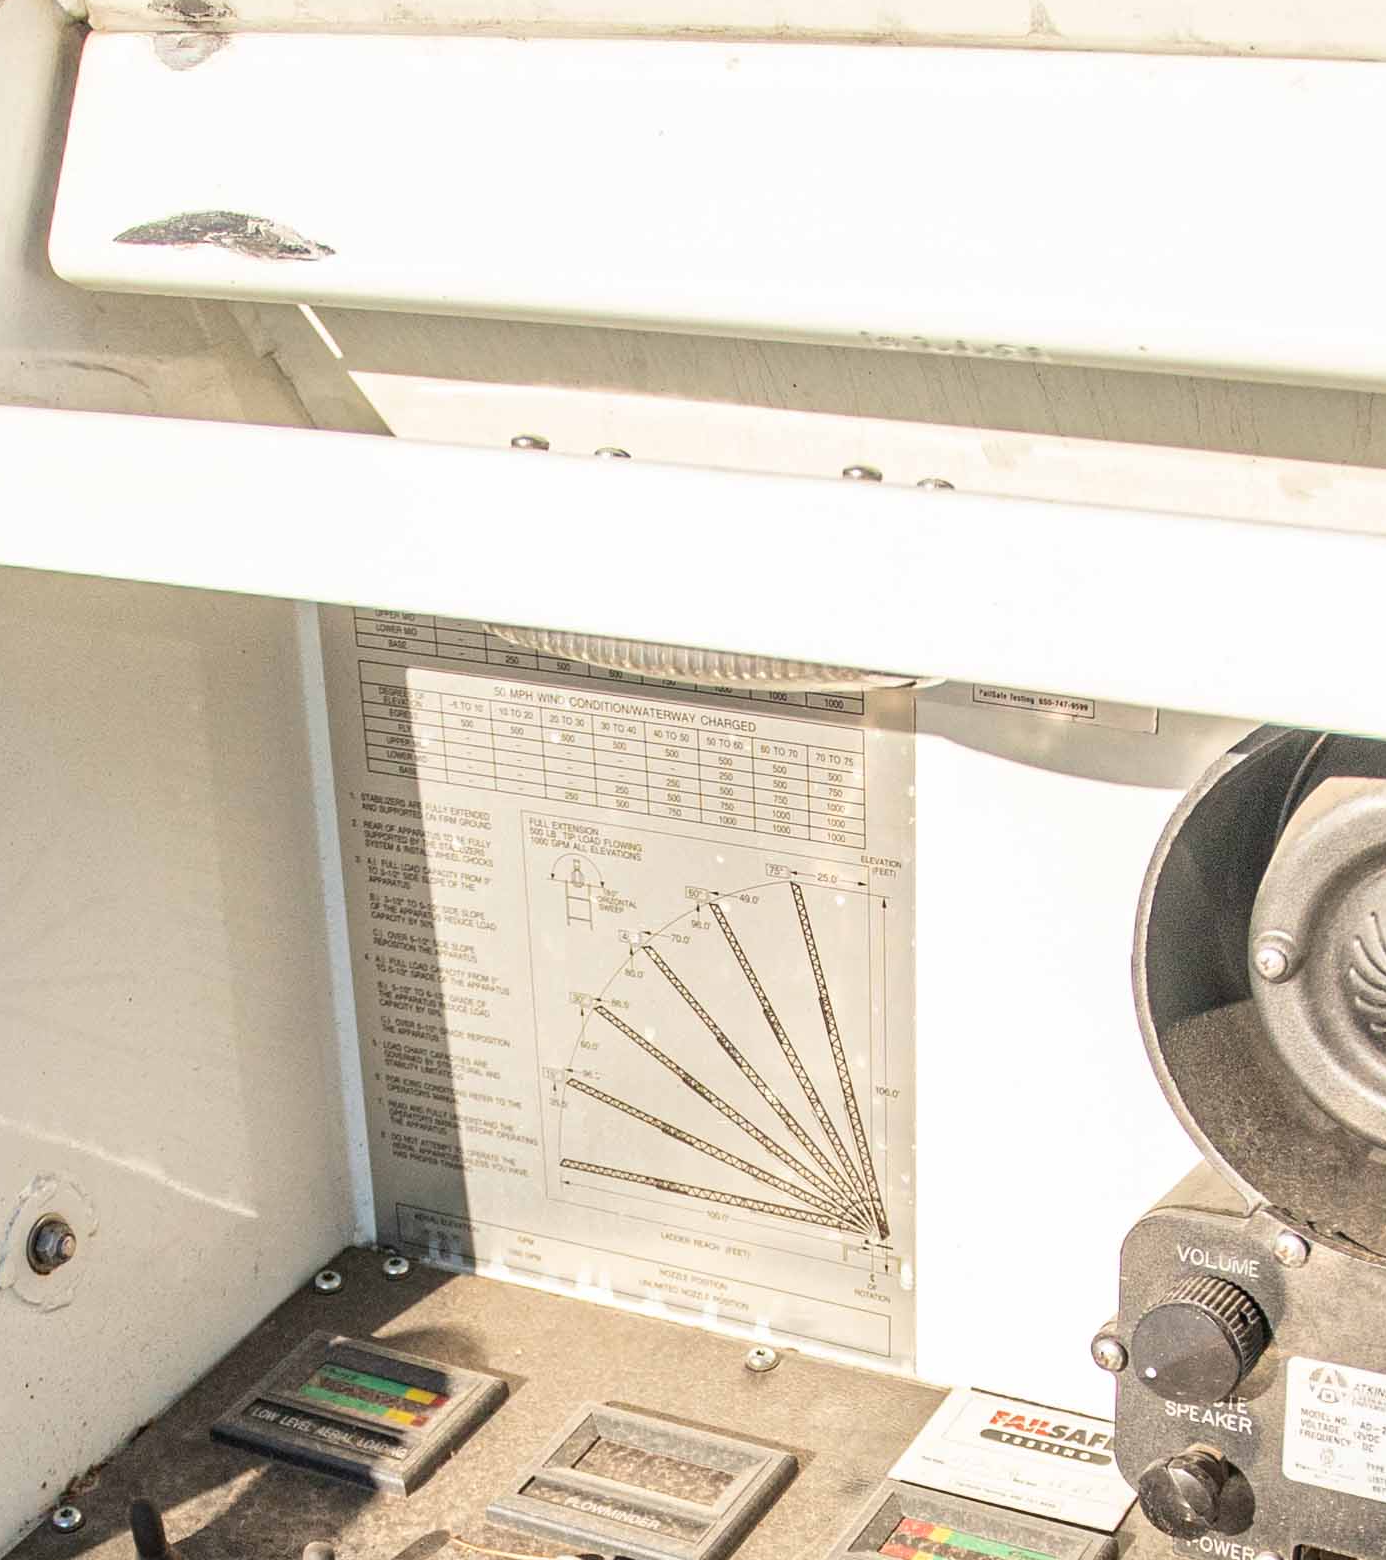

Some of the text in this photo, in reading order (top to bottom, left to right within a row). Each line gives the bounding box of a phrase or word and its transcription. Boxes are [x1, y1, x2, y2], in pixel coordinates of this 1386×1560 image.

[824, 698, 845, 709] 1000
[1010, 692, 1035, 705] Testing
[494, 686, 756, 732] 50 MPH WIND CONDITION/WATERWAY CHARGED
[613, 723, 624, 733] TO
[627, 726, 637, 735] 40
[654, 729, 689, 743] 40 TO 50
[719, 739, 731, 749] TO
[773, 747, 785, 756] TO
[788, 749, 798, 758] 70
[665, 748, 843, 783] 500 500 500 500
[816, 753, 853, 766] 70 TO 75
[773, 779, 843, 798] 500 750
[773, 795, 788, 805] 750
[667, 792, 846, 828] 500 1000 1000
[529, 817, 599, 836] FULL EXTENSION
[668, 807, 846, 843] 750 1000 1000 1000
[573, 841, 587, 852] ALL
[589, 844, 642, 861] ELEVATIONS
[577, 834, 601, 845] LOAD
[603, 838, 643, 852] FLOWING
[860, 855, 902, 869] ELEVATION
[1177, 1245, 1261, 1278] VOLUME
[251, 1407, 278, 1422] LOW
[279, 1415, 311, 1431] LEVEL
[315, 1425, 352, 1441] AERIAL
[1165, 1400, 1253, 1435] SPEAKER
[1001, 1434, 1091, 1460] TESTING
[564, 1496, 661, 1529] FLOWMINDER
